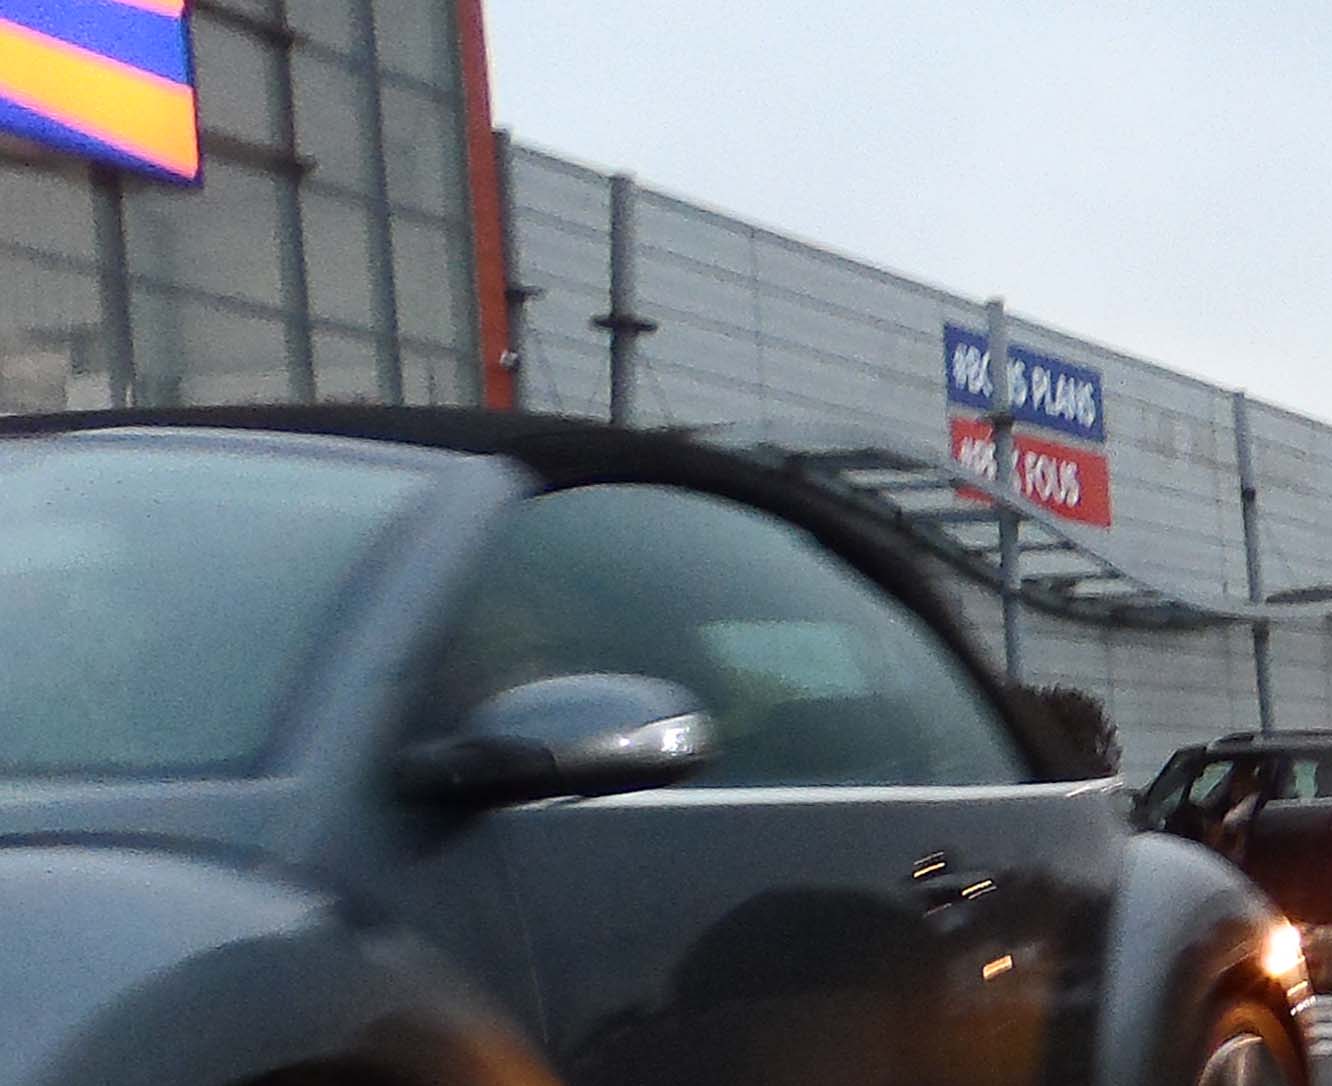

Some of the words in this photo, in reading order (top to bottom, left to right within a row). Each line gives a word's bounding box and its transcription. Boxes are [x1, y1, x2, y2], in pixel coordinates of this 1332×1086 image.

[953, 342, 1027, 408] #BOS
[1031, 365, 1096, 428] PLANS
[1025, 451, 1080, 508] FOUS
